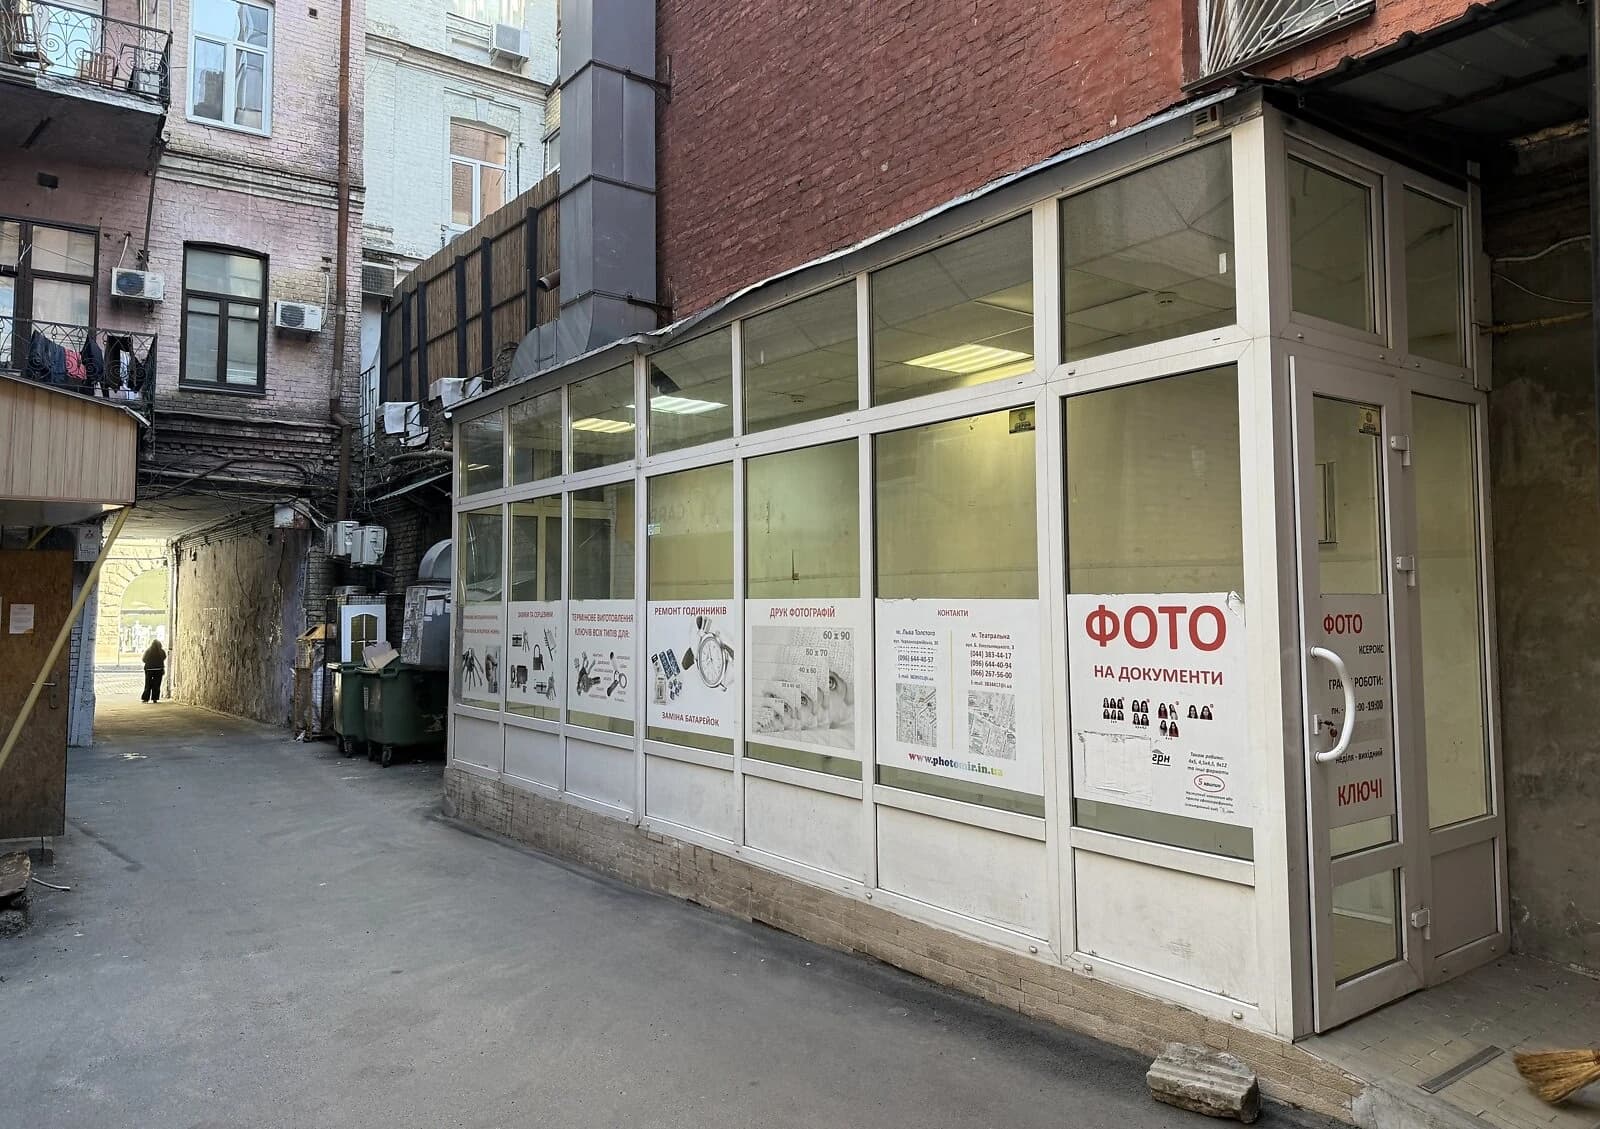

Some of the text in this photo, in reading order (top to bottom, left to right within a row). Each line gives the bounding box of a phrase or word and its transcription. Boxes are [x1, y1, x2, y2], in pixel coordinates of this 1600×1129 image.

[654, 606, 727, 616] РЕМОНТ ГОДИННИКІВ
[769, 605, 836, 619] ДРУК ФОТОГРАФІЙ
[937, 609, 969, 617] КОНТАКТИ
[1085, 604, 1227, 652] ФОТО
[1323, 613, 1363, 635] ФОТО
[822, 630, 833, 640] 60
[840, 631, 850, 641] 90
[979, 632, 1010, 640] Театральна
[820, 649, 828, 657] 70
[971, 650, 1012, 659] (044) 383-44-17
[1358, 644, 1385, 655] КСЕРОКС
[971, 659, 1012, 669] (096) 644-40-94
[971, 669, 1013, 679] (066) 267-56-00
[1094, 665, 1224, 686] НА ДОКУМЕНТИ
[1354, 675, 1384, 688] РОБОТИ:
[661, 711, 720, 727] ЗАМІНА БАТАРЕЙОК
[1358, 747, 1383, 761] вихідний
[908, 752, 1004, 777] www.photomir.in.ua
[1197, 777, 1203, 786] 5
[1337, 778, 1383, 807] КЛЮЧІ
